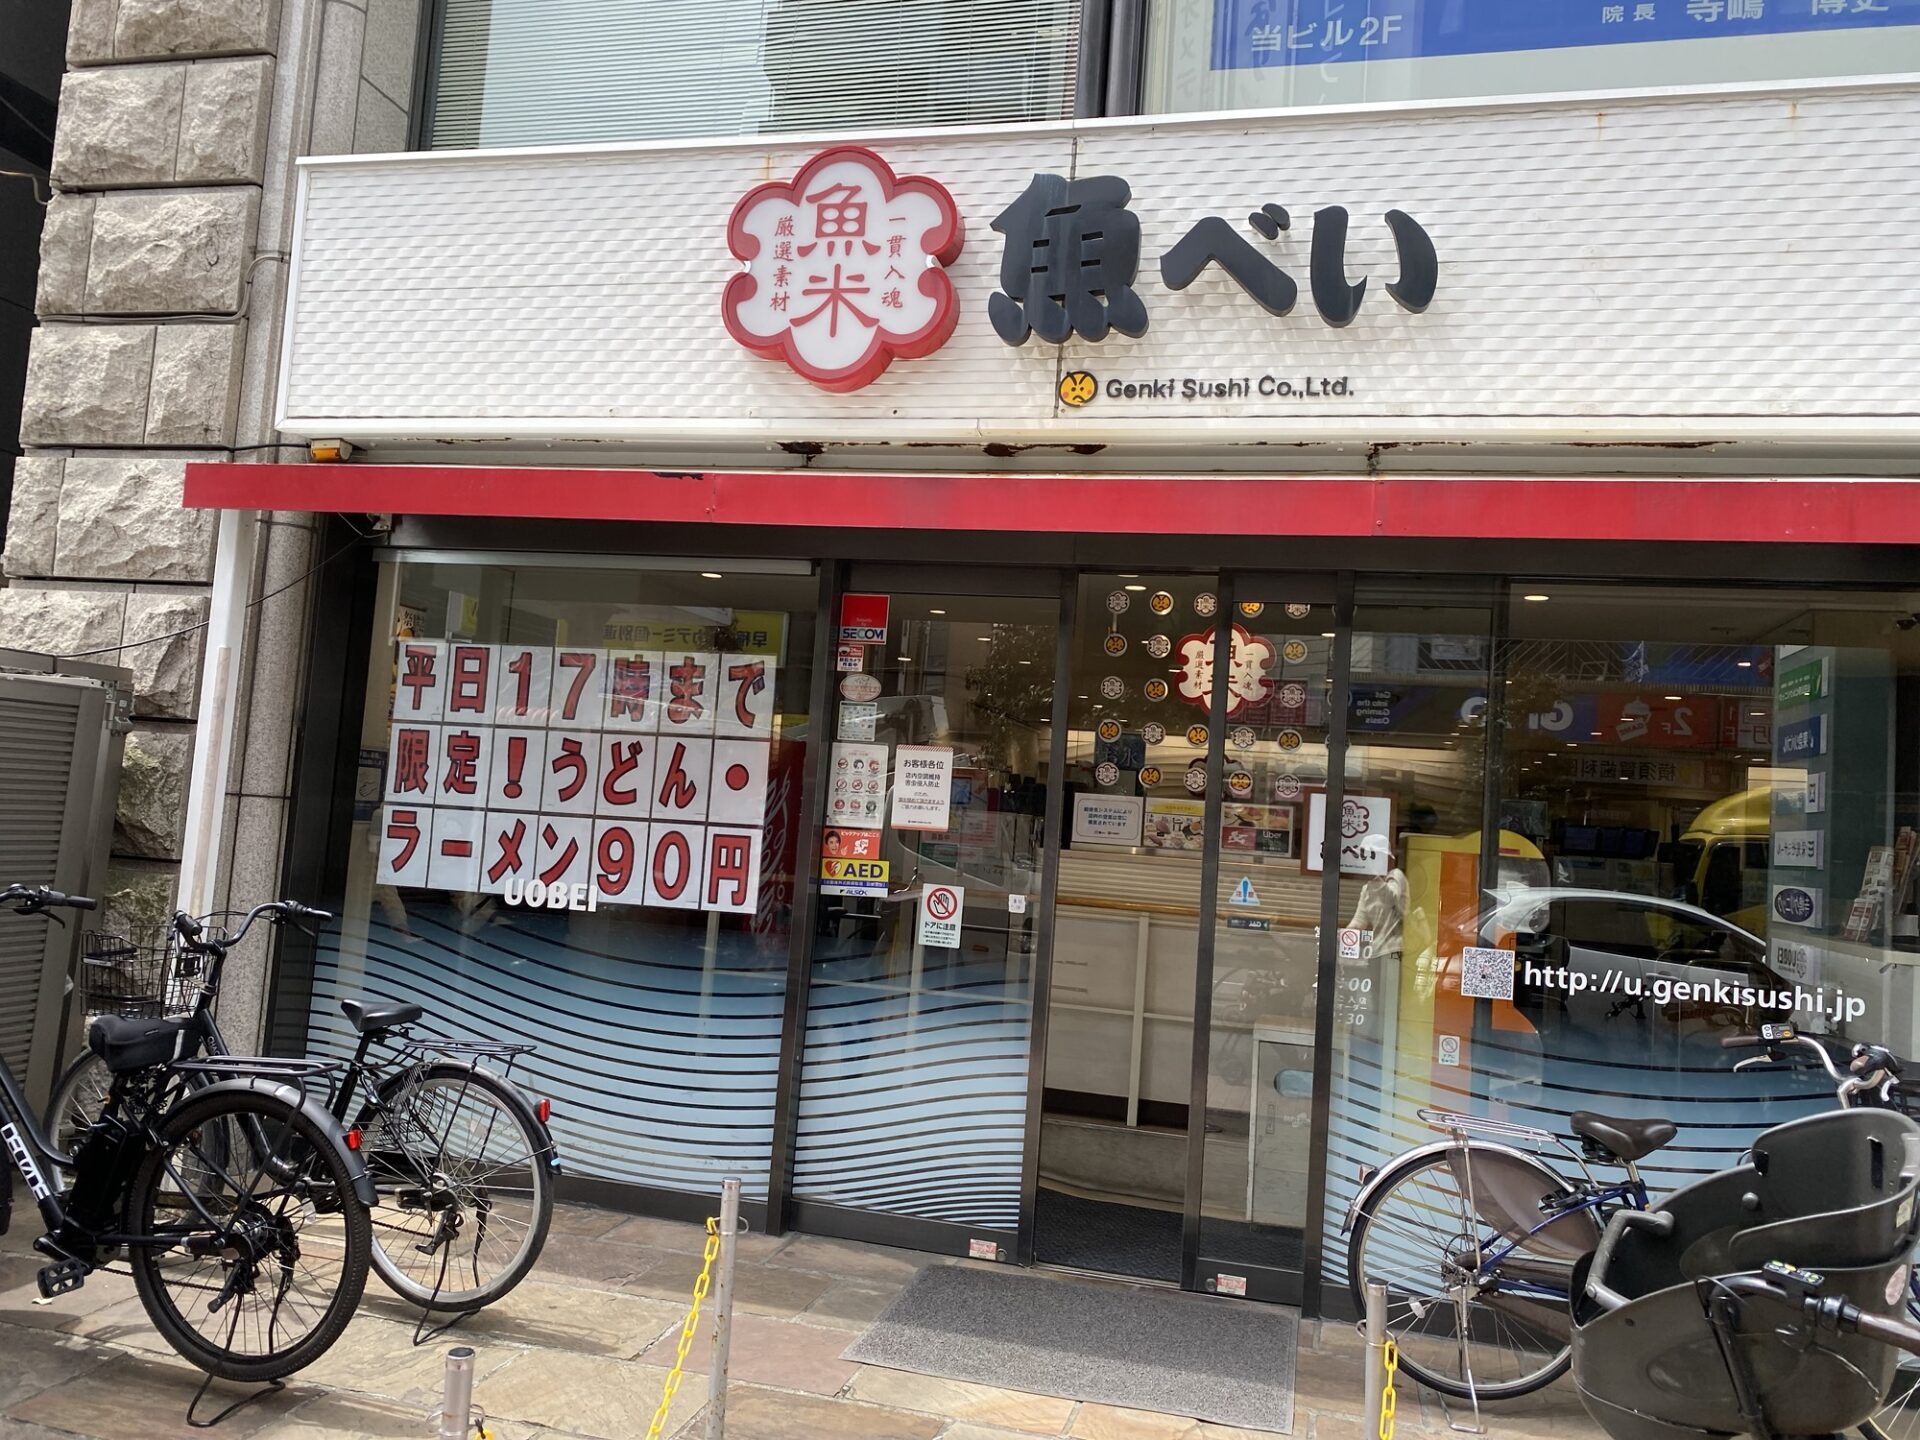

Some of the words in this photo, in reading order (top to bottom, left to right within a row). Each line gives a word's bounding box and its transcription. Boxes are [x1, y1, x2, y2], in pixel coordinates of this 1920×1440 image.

[769, 216, 796, 312] 厳選素材
[789, 183, 881, 338] 魚米
[881, 217, 907, 309] 一貫入魂
[988, 173, 1439, 348] 魚べい
[1106, 377, 1175, 399] Genki
[1182, 376, 1250, 398] Sushi
[1258, 376, 1355, 400] Co.,Ltd.
[842, 628, 884, 640] SECOM
[402, 645, 765, 728] 平日17時まで
[903, 759, 945, 770] お客様各位
[387, 810, 752, 907] ラーメン90円
[843, 863, 884, 879] AED
[504, 878, 598, 913] UOBEI
[1522, 960, 1867, 1023] http://u.genkisushi.jp
